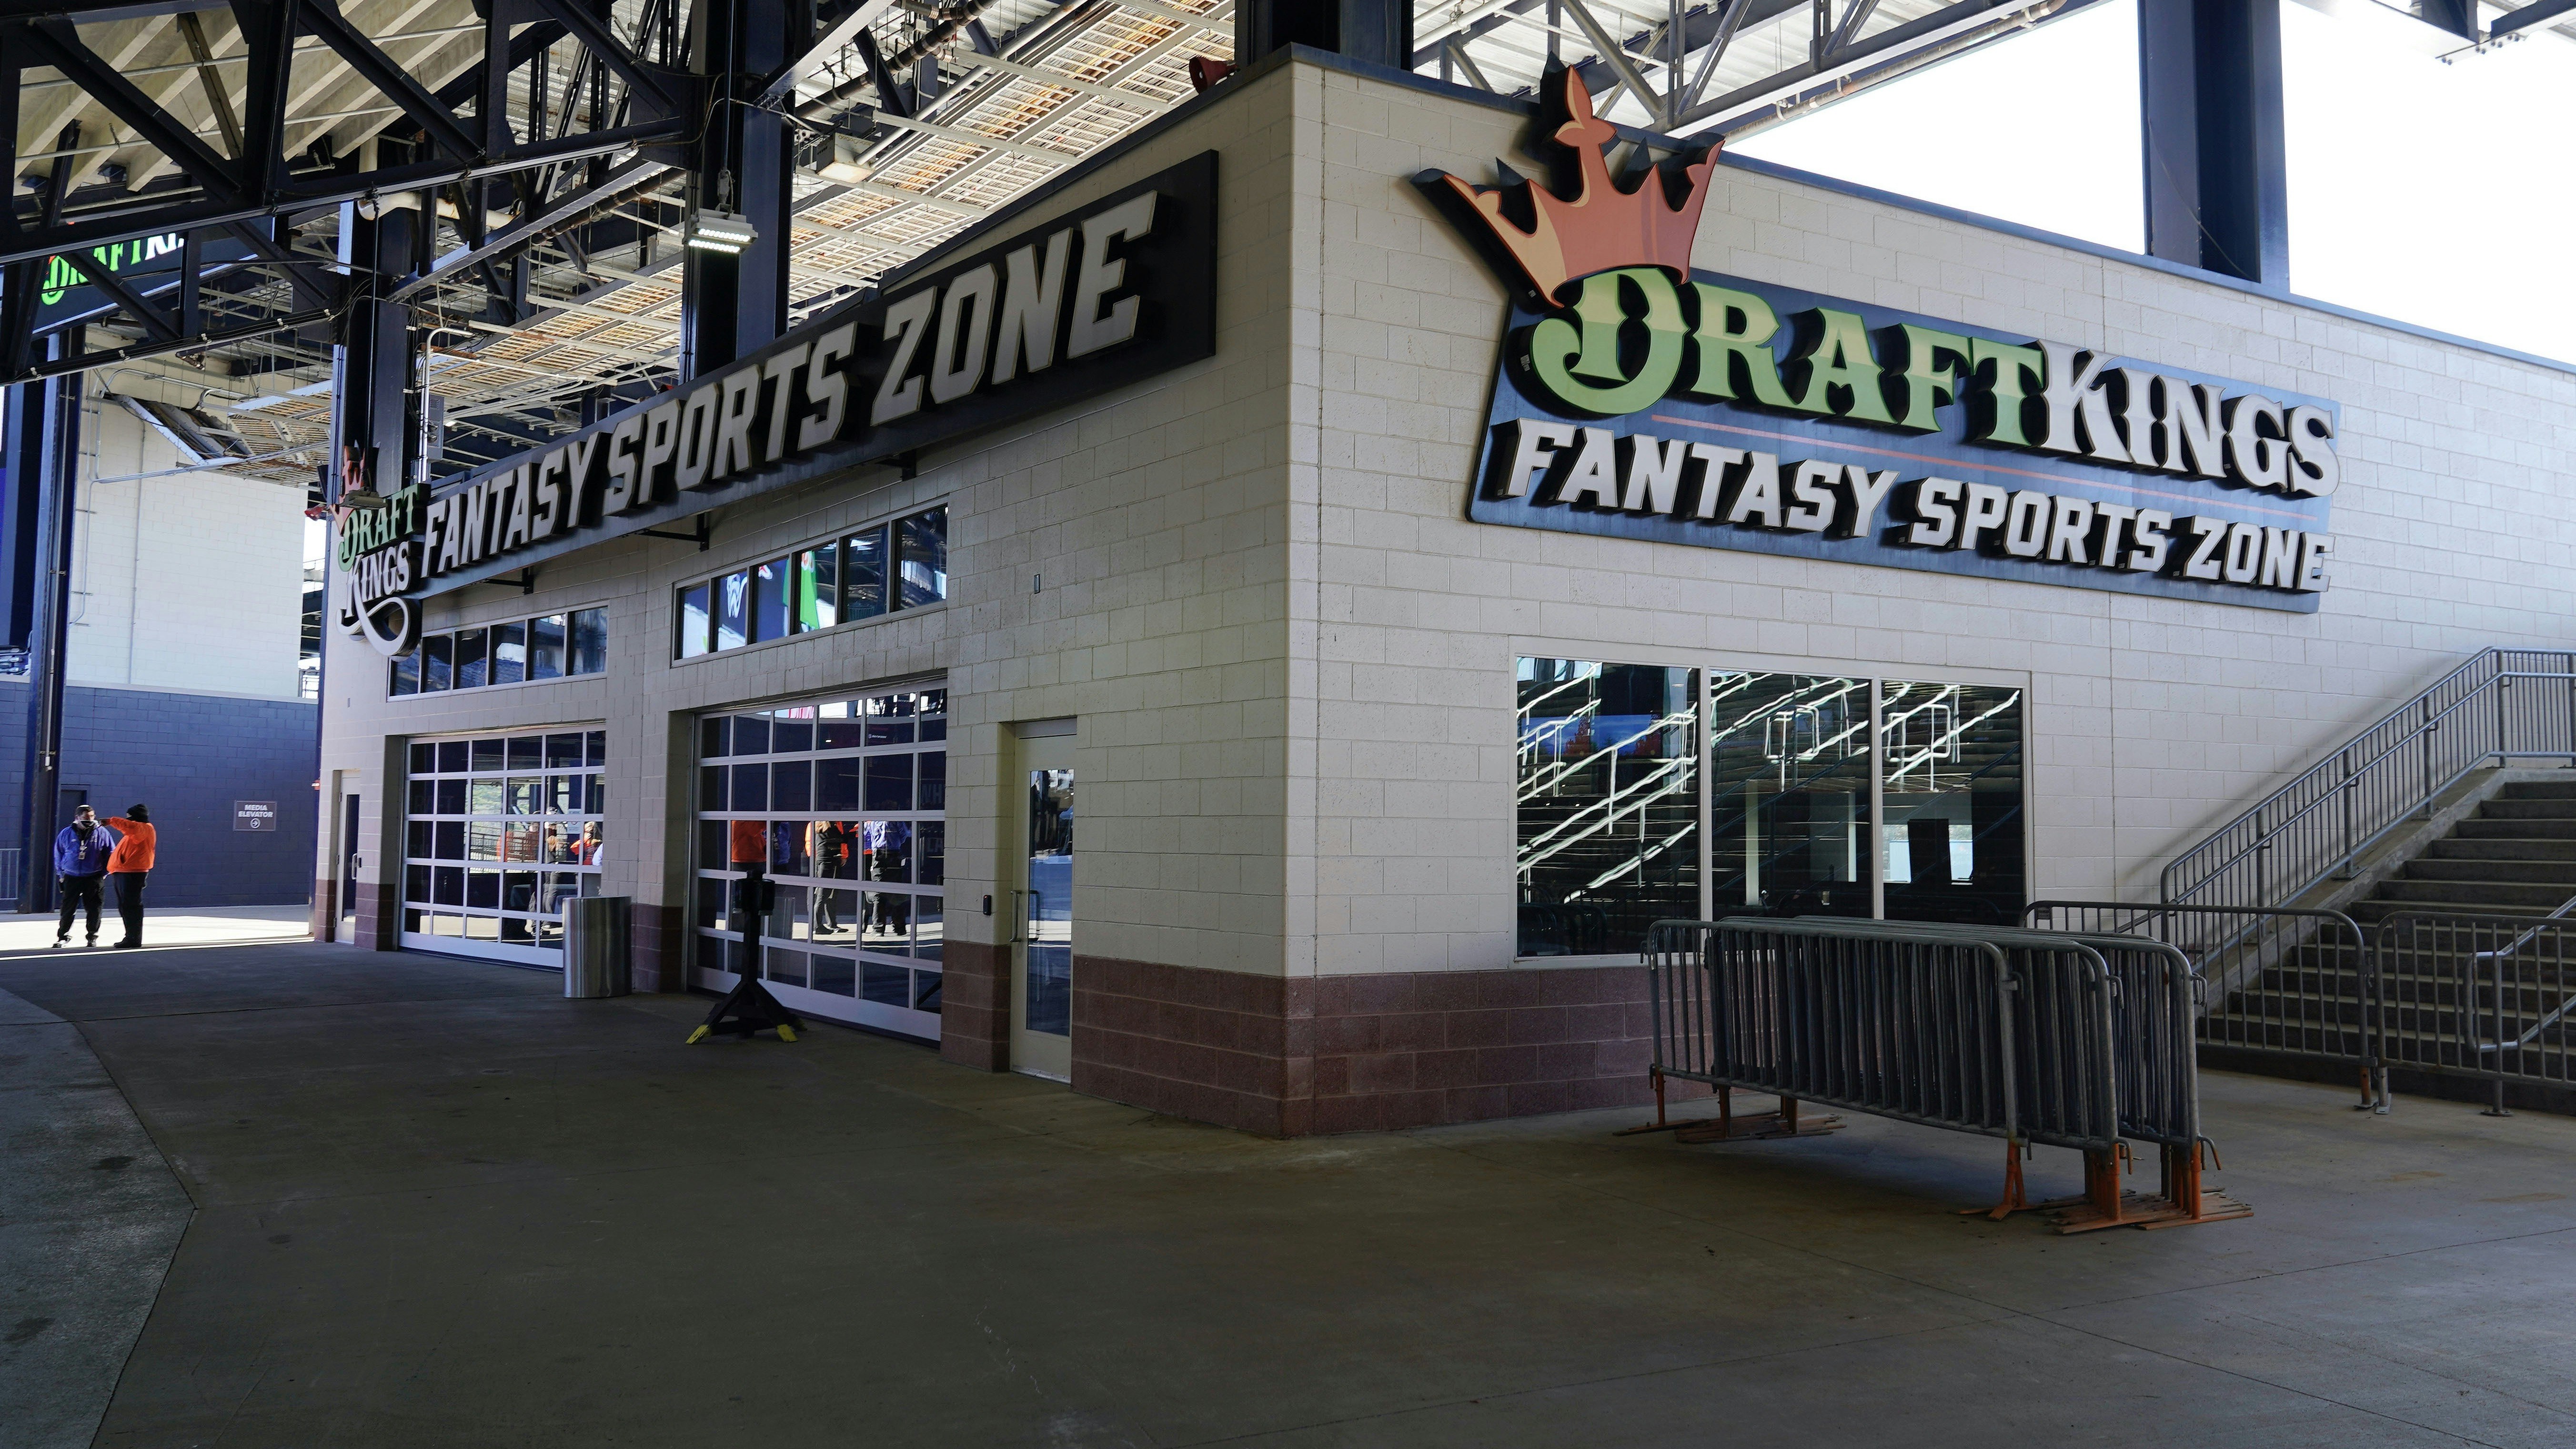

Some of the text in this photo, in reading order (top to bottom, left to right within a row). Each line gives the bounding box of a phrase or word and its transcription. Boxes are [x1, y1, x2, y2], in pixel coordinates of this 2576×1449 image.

[421, 190, 1158, 578] FANTASY SPORTS ZONE
[1530, 267, 2341, 497] DRAFTKINGS
[338, 483, 420, 572] DRAFT
[1507, 417, 2336, 593] FANTASY SPORTS ZONE
[336, 541, 412, 657] KINGS
